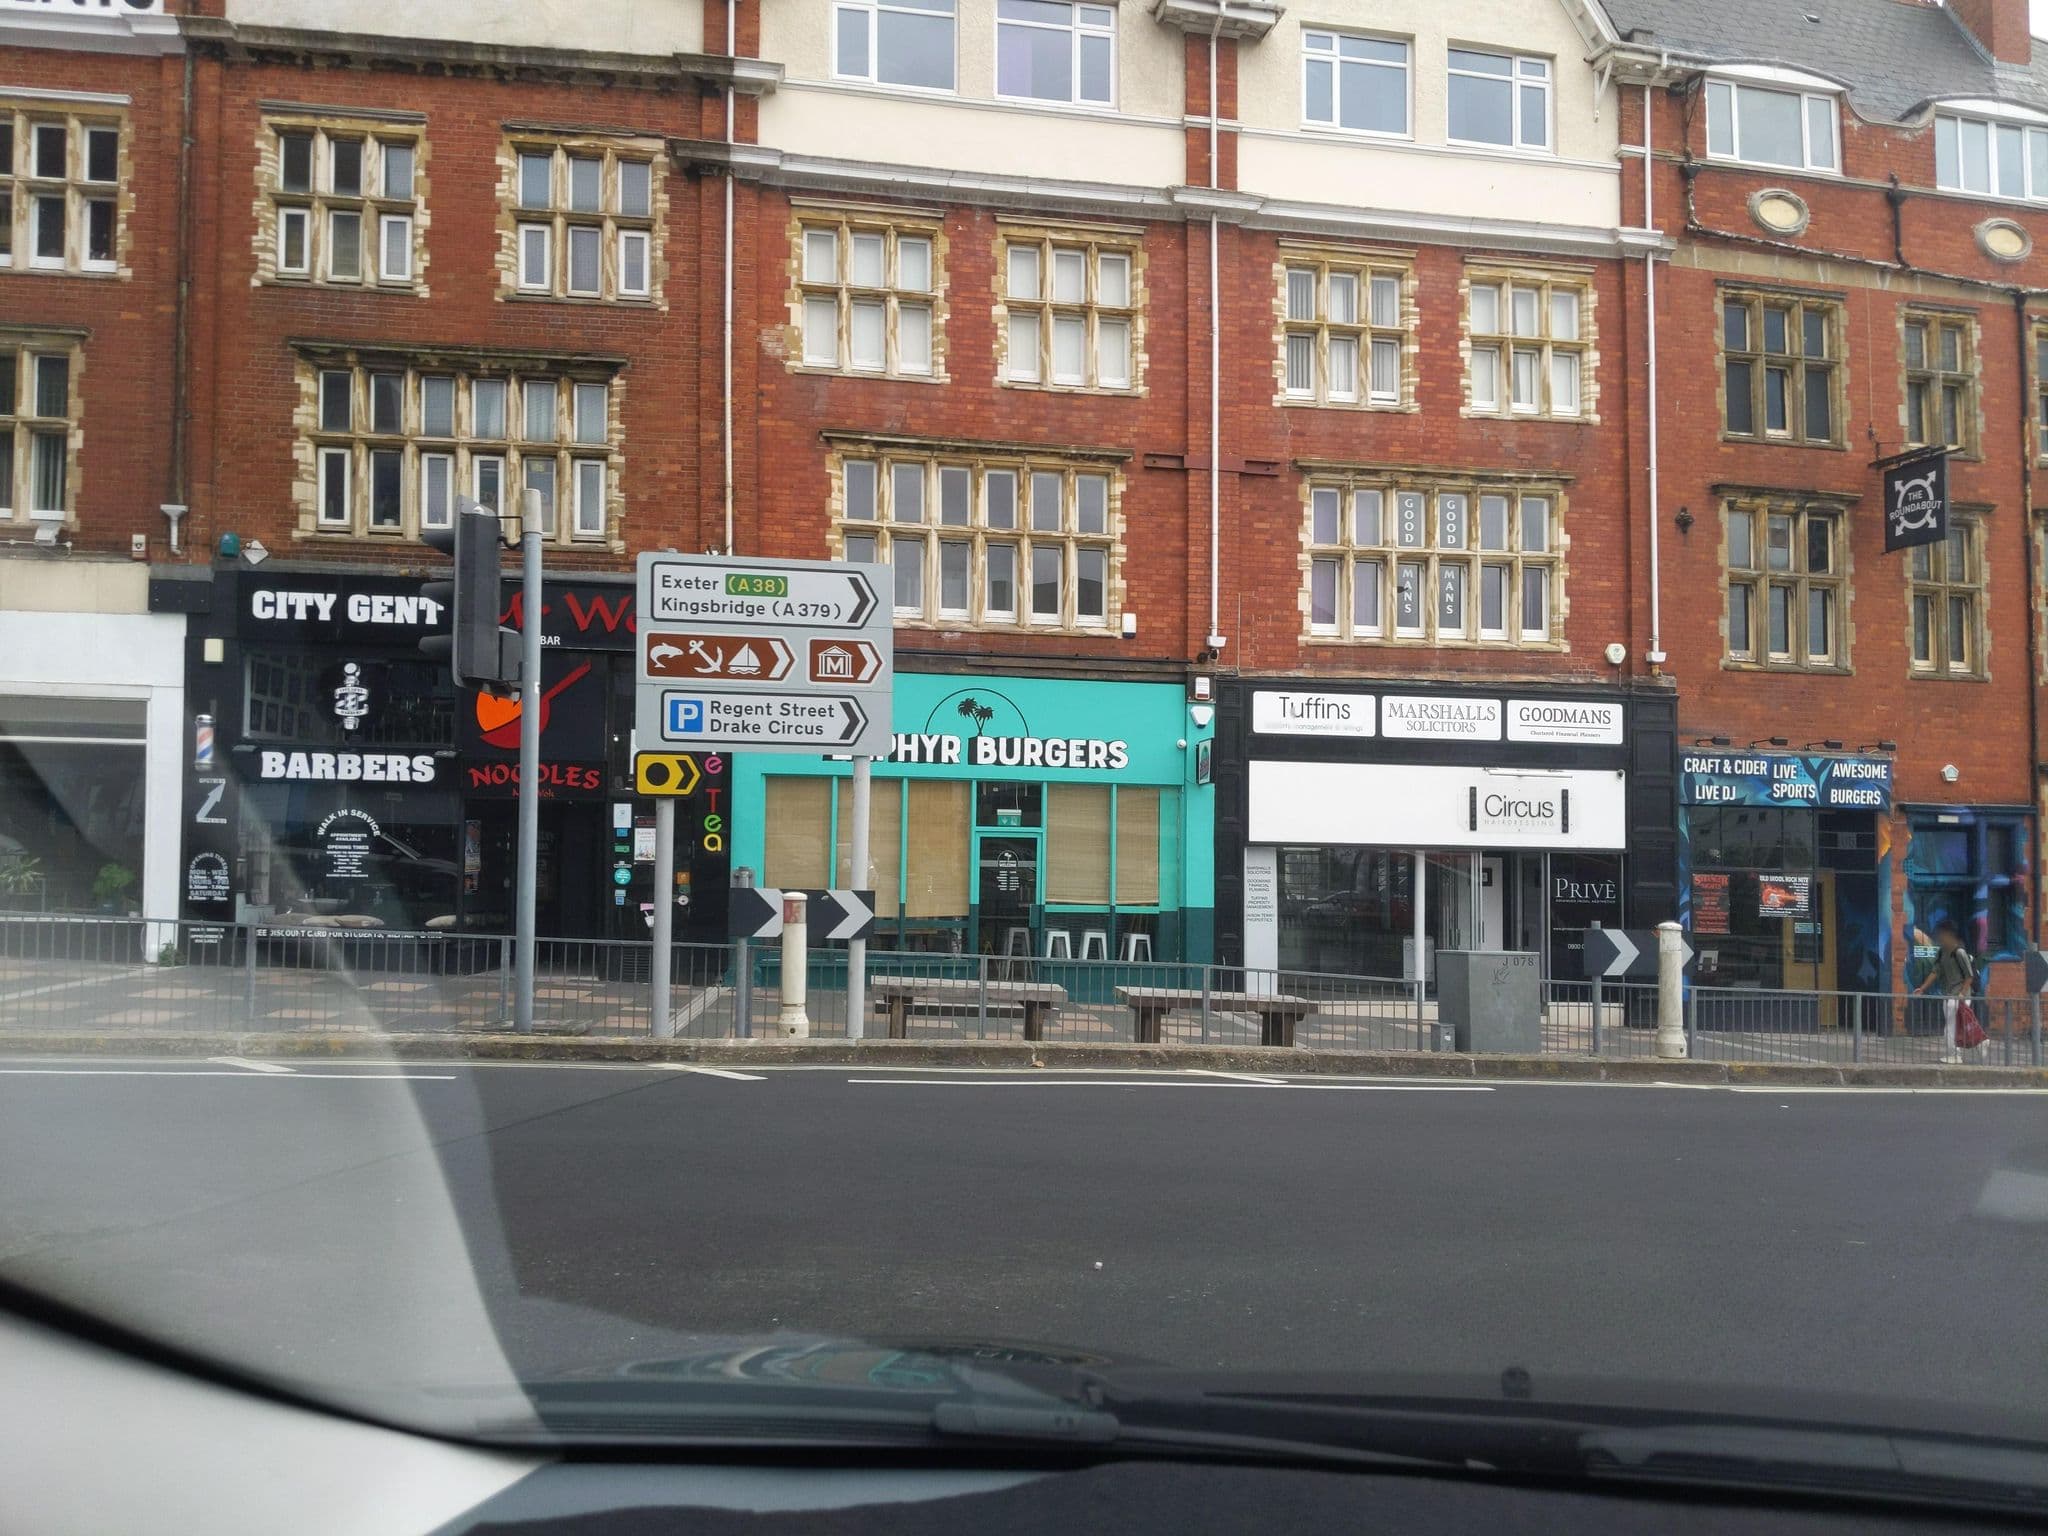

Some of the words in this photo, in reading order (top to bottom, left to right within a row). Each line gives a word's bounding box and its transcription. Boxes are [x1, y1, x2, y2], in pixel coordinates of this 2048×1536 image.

[1907, 490, 1923, 501] THE
[1889, 500, 1942, 520] ROUNDABOUT
[661, 574, 720, 591] Exeter
[728, 576, 786, 596] (A38)
[252, 590, 337, 621] CITY
[661, 597, 766, 617] Kingsbridge
[772, 600, 842, 620] (A379)
[539, 635, 561, 646] BAR
[677, 703, 699, 729] P
[709, 700, 773, 720] Regent
[779, 703, 835, 718] Street
[1279, 696, 1351, 720] Tuffins
[1387, 702, 1496, 721] MARSHALLS
[1519, 706, 1612, 724] GOODMANS
[709, 719, 762, 734] Drake
[768, 720, 824, 735] Circus
[1406, 720, 1477, 733] SOLICITORS
[972, 735, 1130, 770] BURGERS
[260, 751, 436, 782] BARBERS
[1684, 758, 1721, 774] CRAFT
[1723, 759, 1732, 774] &
[1734, 759, 1768, 775] CIDER
[1773, 764, 1797, 779] LIVE
[1832, 763, 1888, 779] AWESOME
[1695, 784, 1720, 800] LIVE
[1721, 785, 1737, 801] DJ
[1773, 783, 1817, 799] SPORTS
[1830, 788, 1882, 805] BURGERS
[1484, 794, 1554, 818] Circus
[317, 813, 337, 835] WALK
[337, 808, 349, 817] IN
[350, 809, 381, 837] SERVICE
